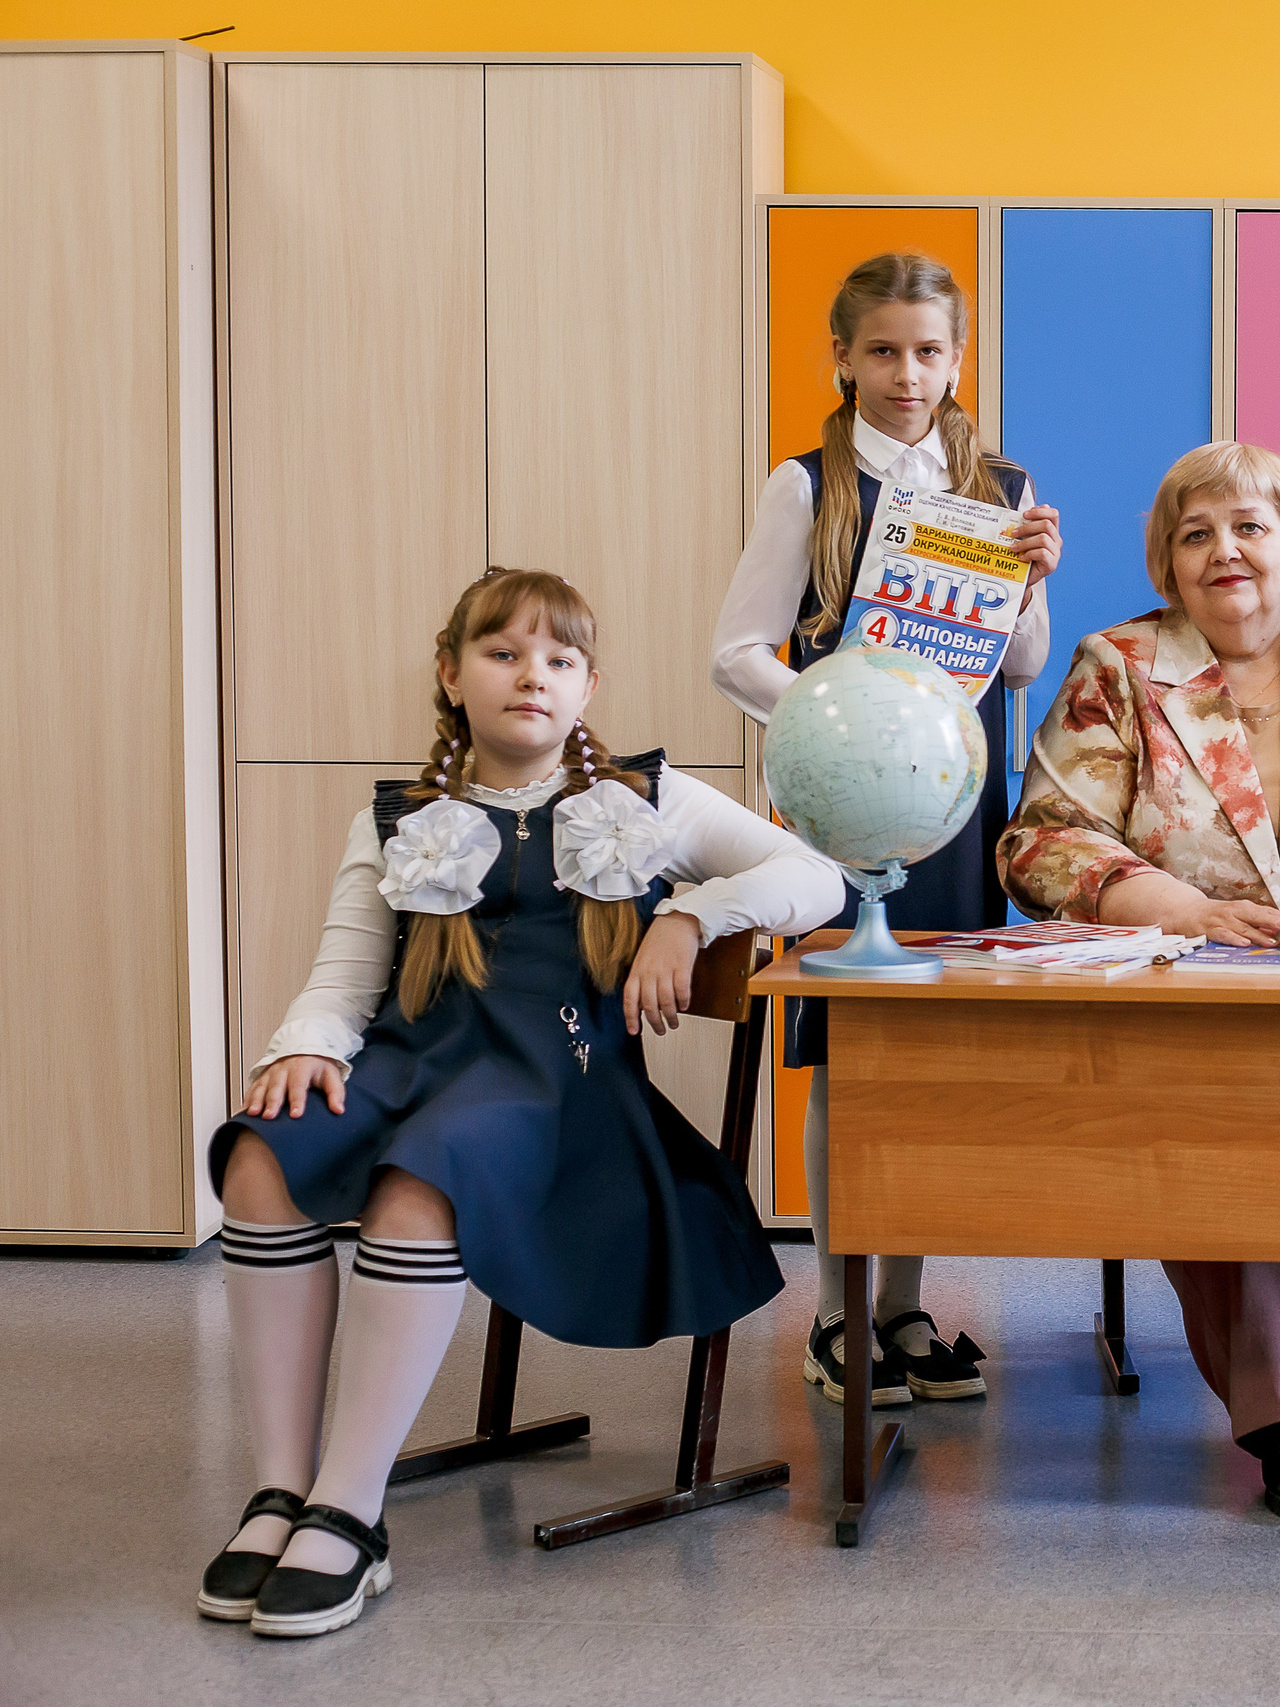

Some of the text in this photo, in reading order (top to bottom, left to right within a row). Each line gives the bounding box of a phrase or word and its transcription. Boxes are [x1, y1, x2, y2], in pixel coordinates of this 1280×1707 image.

[888, 505, 912, 515] ФИОКО
[918, 498, 939, 508] ОЦЕНКИ
[938, 503, 963, 514] КАЧЕСТВА
[963, 508, 999, 523] ОБРАЗОВАНИЯ
[929, 494, 992, 514] ФЕДЕРАЛЬНЫЙ ИНСТИТУТ
[884, 523, 907, 545] 25
[915, 526, 973, 546] ВАРИАНТОВ
[909, 547, 1016, 580] ВСЕРОССИЙСКАЯ ПРОВЕРОЧНАЯ РАБОТА
[913, 538, 1019, 572] ОКРУЖАЮЩИЙ МИР
[872, 552, 1010, 626] ВПР
[867, 615, 888, 644] 4
[900, 619, 997, 655] ТИПОВЫЕ
[897, 639, 988, 671] ЗАДАНИЯ
